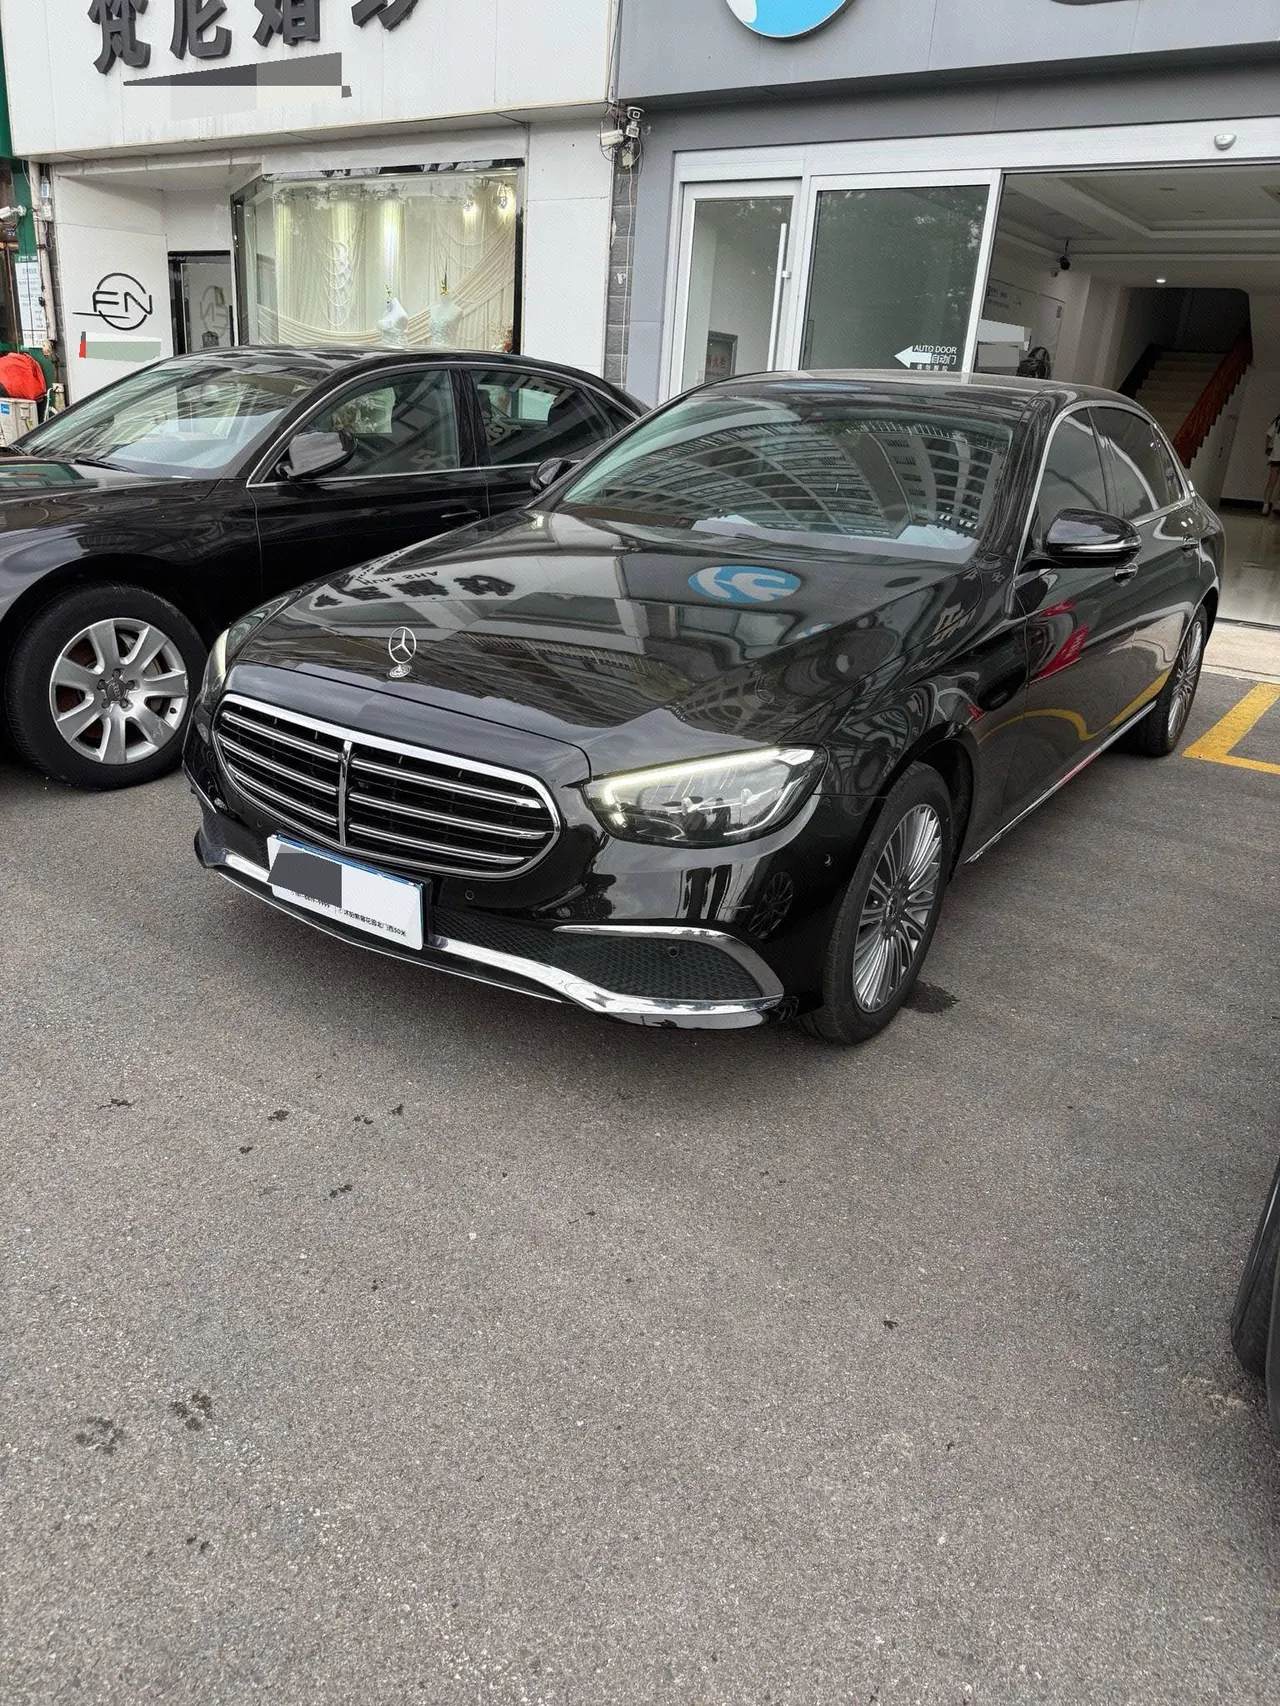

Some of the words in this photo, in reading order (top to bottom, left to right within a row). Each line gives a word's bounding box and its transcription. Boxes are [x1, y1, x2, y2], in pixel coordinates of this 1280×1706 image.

[913, 344, 934, 352] AUTO
[935, 346, 957, 354] DOOR
[931, 354, 957, 365] 自动门
